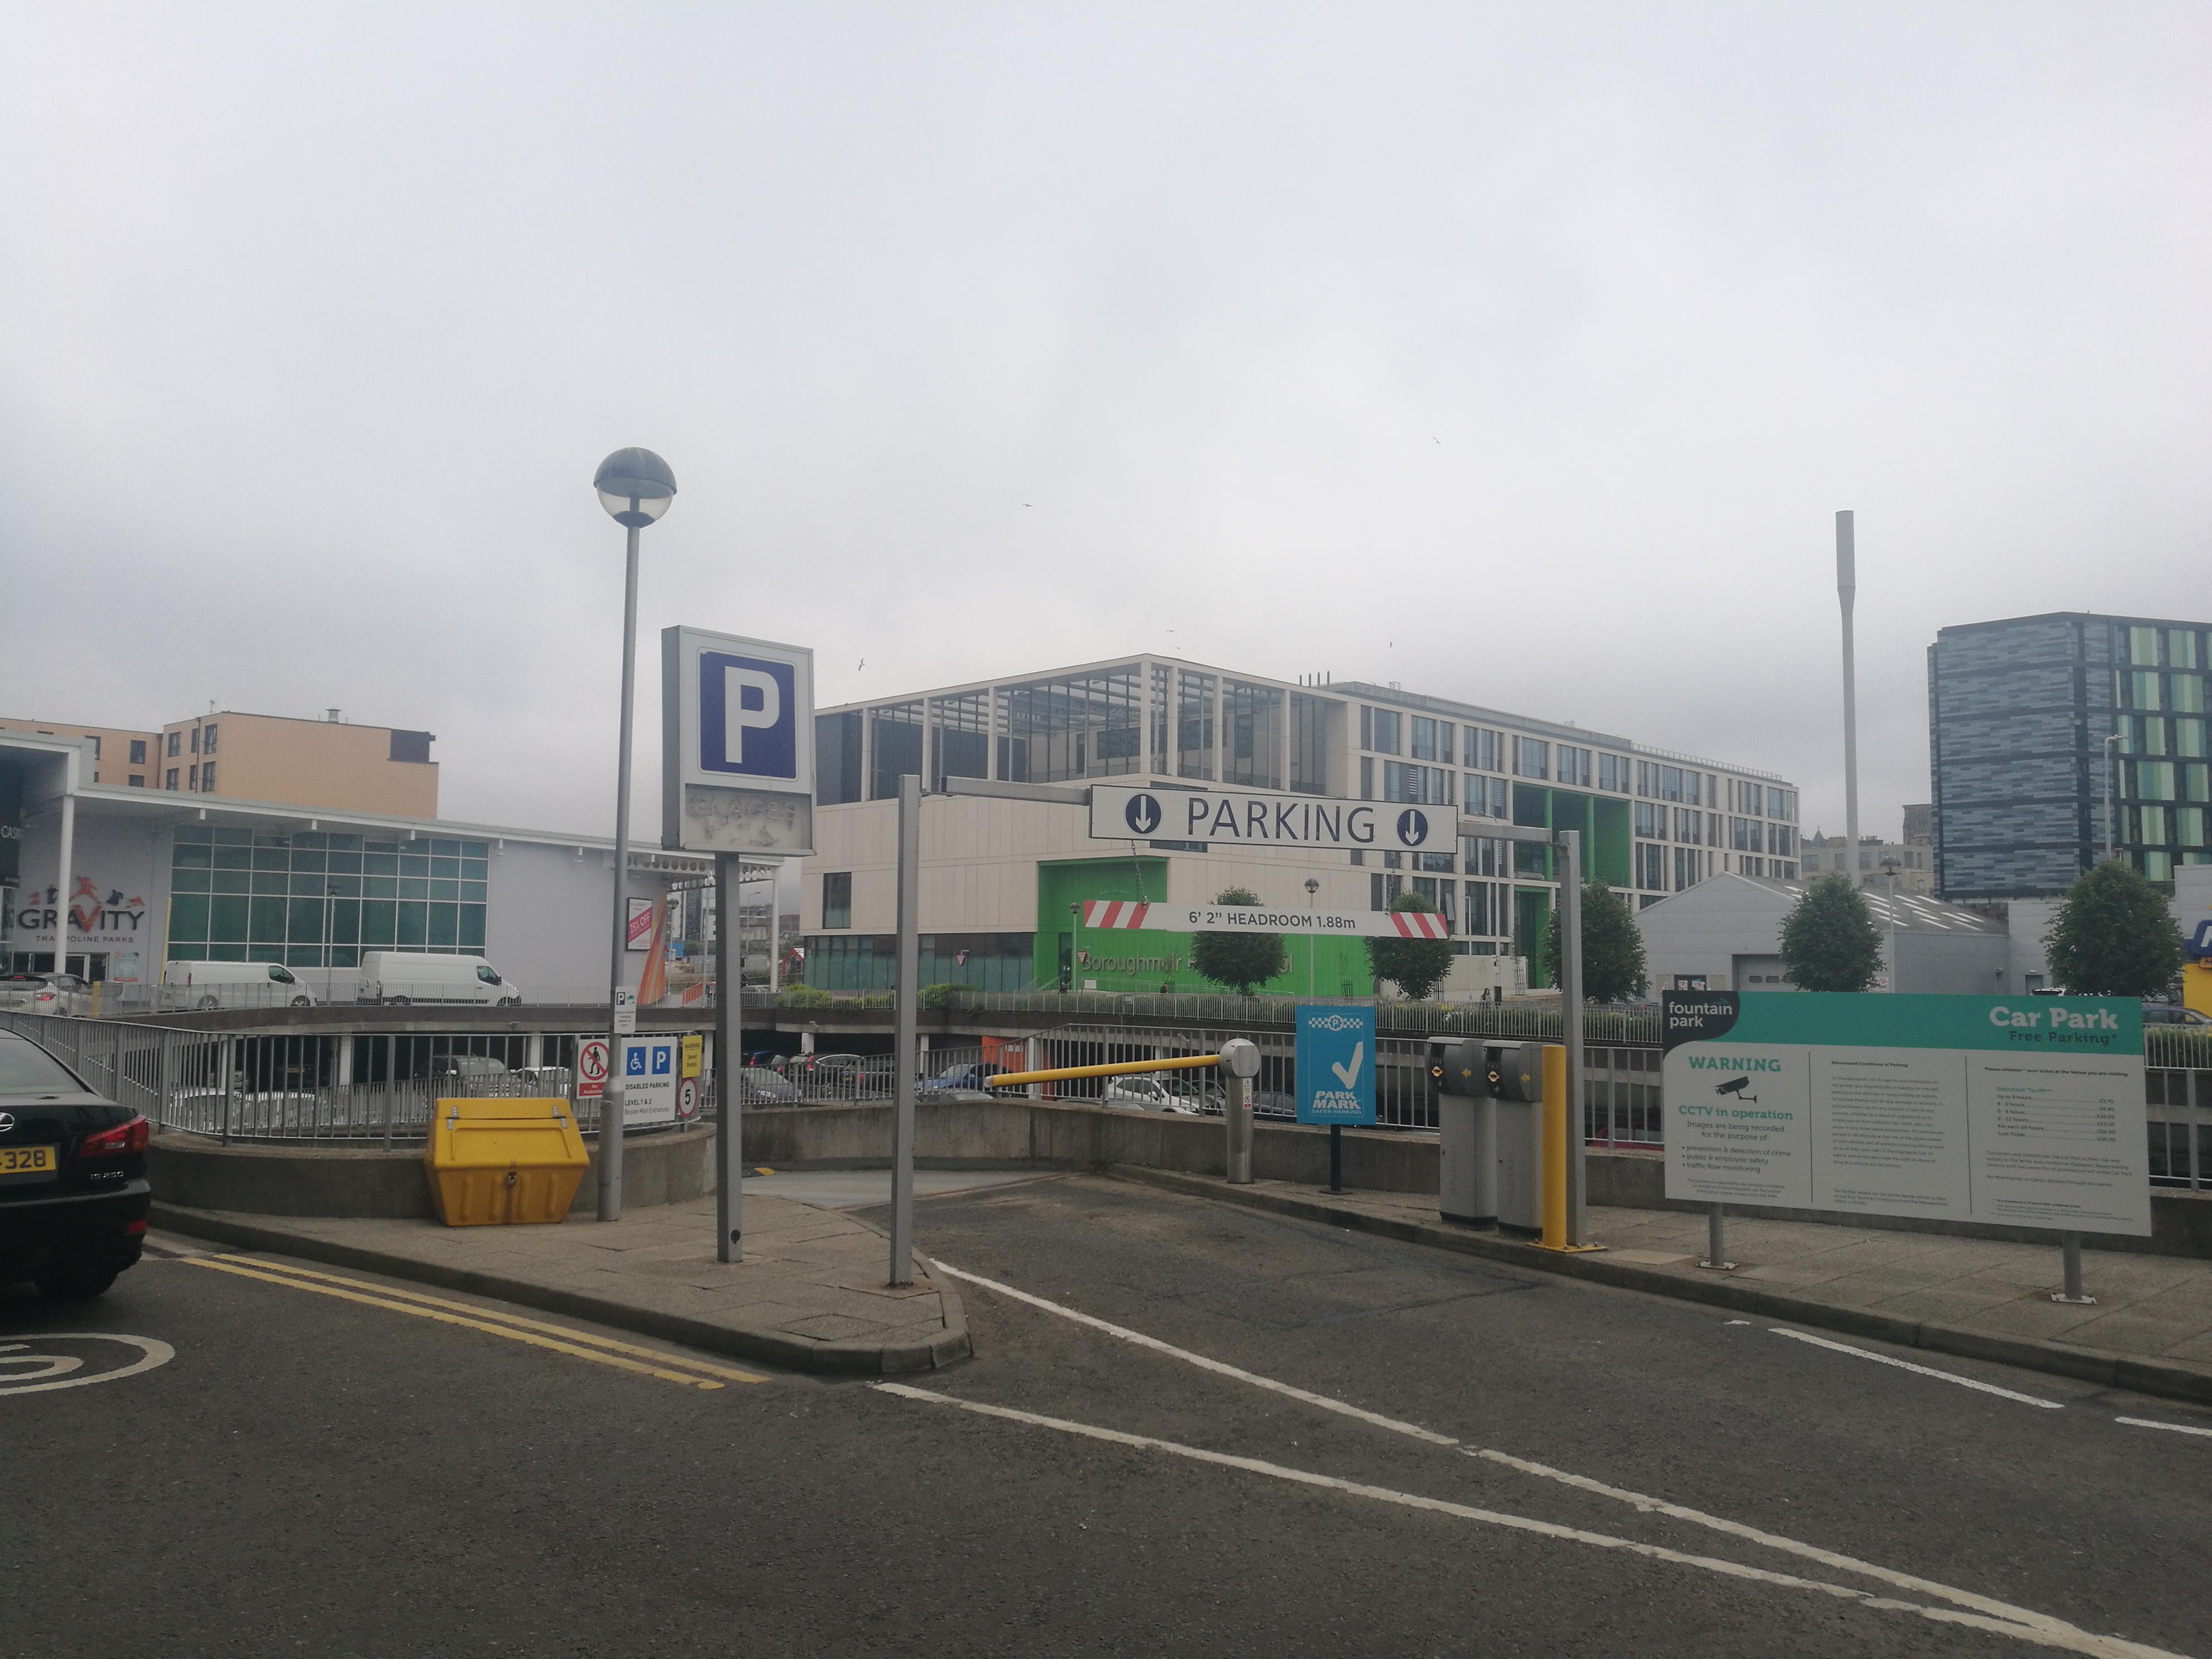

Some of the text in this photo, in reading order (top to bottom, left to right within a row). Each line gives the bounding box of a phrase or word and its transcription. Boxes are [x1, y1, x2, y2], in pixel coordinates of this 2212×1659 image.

[725, 666, 779, 764] P
[1188, 797, 1375, 843] PARKING
[18, 905, 145, 932] GRAVITY
[1228, 913, 1312, 928] HEADROOM
[1316, 915, 1355, 928] 1.88m
[1668, 1001, 1732, 1015] fountain
[1670, 1015, 1703, 1029] park
[1988, 1006, 2118, 1030] Car Park
[2009, 1031, 2042, 1042] Free
[656, 1051, 666, 1069] P
[1688, 1056, 1781, 1072] WARNING
[685, 1089, 691, 1105] 5
[1315, 1091, 1356, 1099] PARK
[1312, 1099, 1361, 1109] MARK
[1679, 1105, 1793, 1120] CCTV in operation
[1687, 1120, 1713, 1129] Images
[1729, 1123, 1749, 1131] being
[0, 1149, 46, 1169] 328
[1723, 1165, 1760, 1173] monitoring
